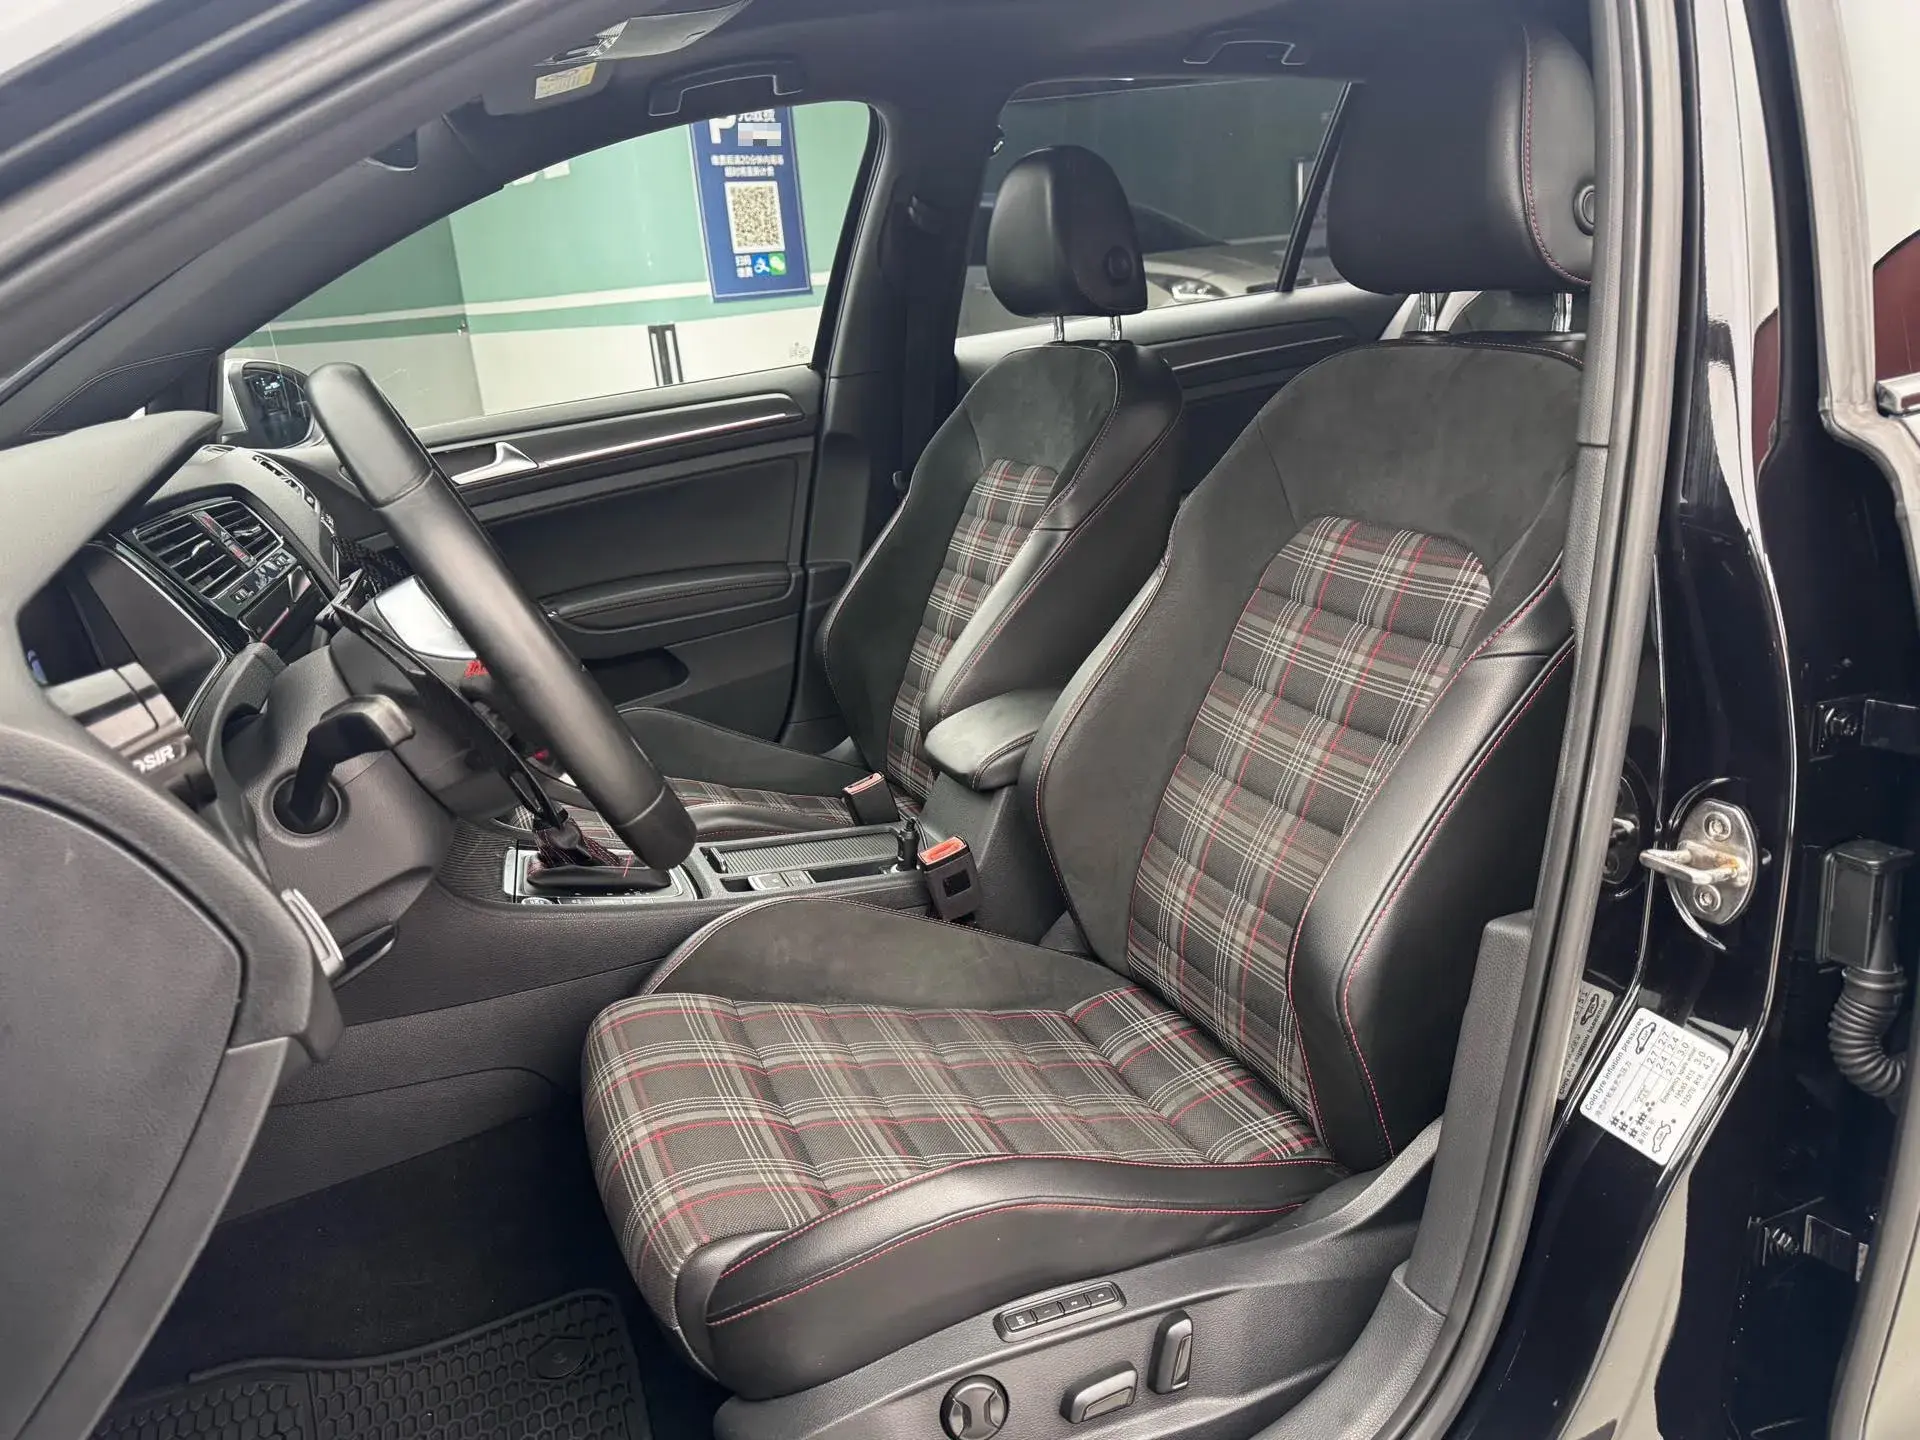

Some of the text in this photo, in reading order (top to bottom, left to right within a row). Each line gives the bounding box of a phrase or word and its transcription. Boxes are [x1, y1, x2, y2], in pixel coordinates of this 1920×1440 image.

[1584, 1016, 1645, 1111] Cold tyre inflation pressures
[1646, 1030, 1670, 1065] 2.7 2.7
[1655, 1035, 1679, 1070] 2.4 2.4
[1664, 1041, 1689, 1075] 2.7 3.0
